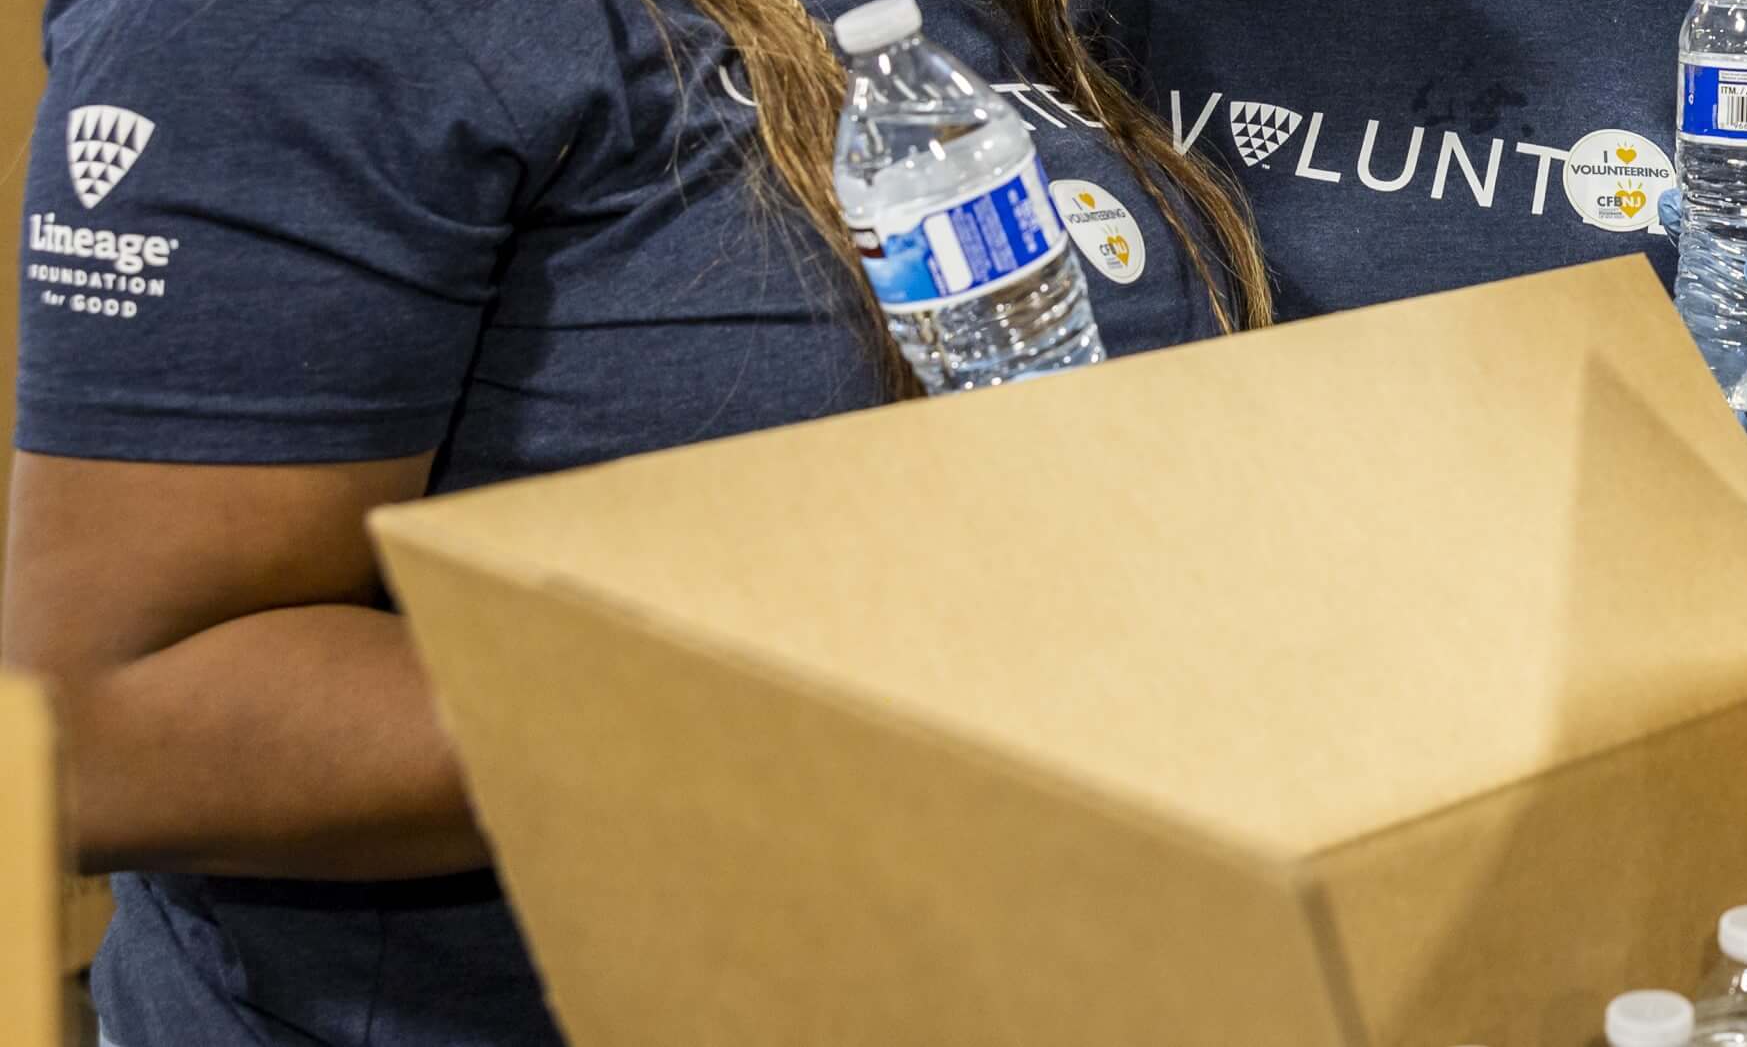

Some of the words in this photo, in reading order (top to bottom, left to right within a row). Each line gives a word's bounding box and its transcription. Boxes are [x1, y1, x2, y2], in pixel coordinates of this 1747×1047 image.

[1571, 164, 1669, 178] VOLUNTEERING
[28, 212, 172, 274] Lineage
[28, 264, 166, 296] FOUNDATION
[41, 289, 66, 306] for
[70, 293, 138, 318] GOOD
